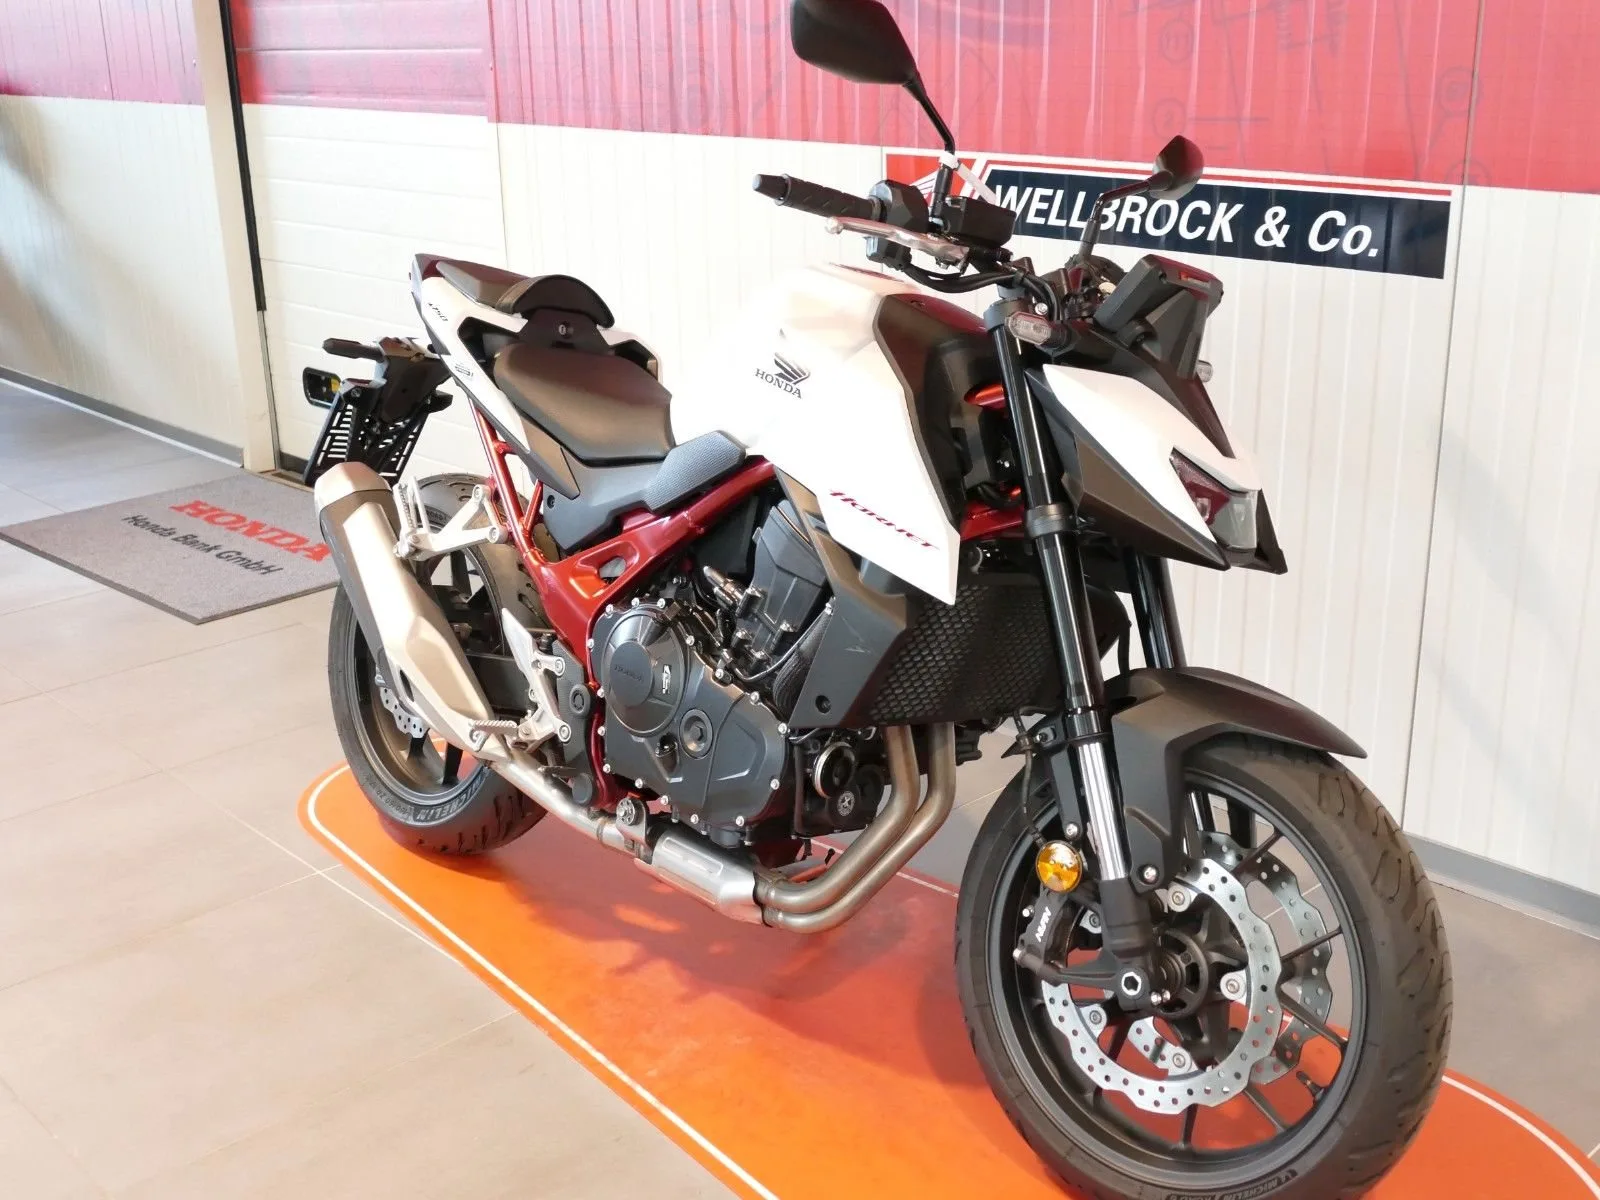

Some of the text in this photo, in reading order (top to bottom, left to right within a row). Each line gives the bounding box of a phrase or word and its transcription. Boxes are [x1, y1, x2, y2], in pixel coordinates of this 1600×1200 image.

[995, 185, 1379, 257] WELLBROCK & Co.
[754, 367, 802, 399] HONDA
[121, 514, 284, 575] Honda Bank GmbH
[168, 500, 332, 562] HONDA
